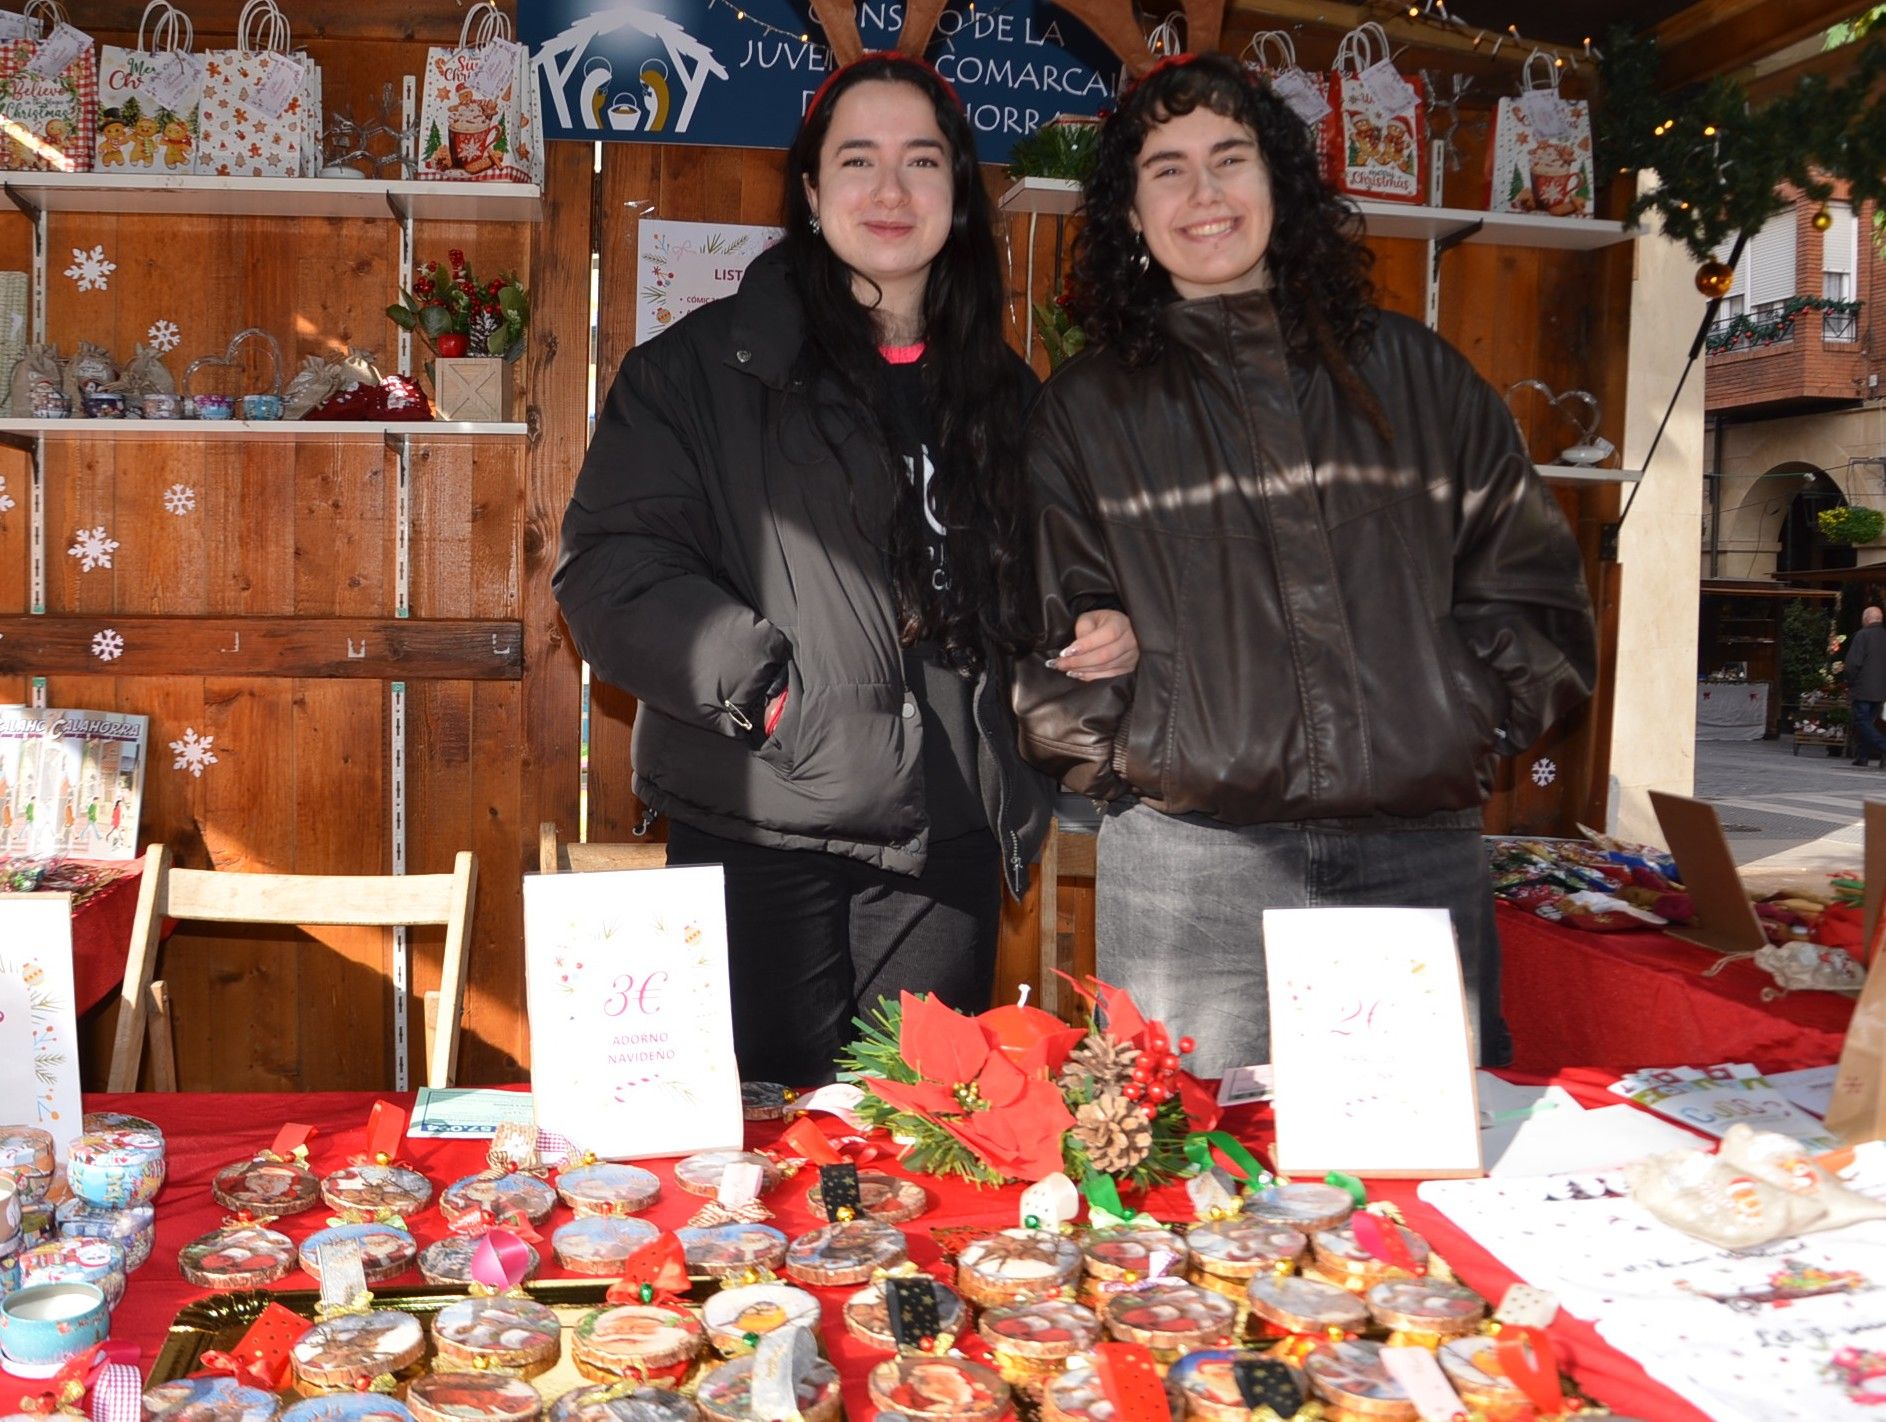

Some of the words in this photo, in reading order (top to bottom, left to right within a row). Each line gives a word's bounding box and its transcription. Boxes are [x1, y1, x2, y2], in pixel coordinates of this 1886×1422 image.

[974, 12, 1014, 42] DE
[1025, 18, 1065, 47] LA
[714, 268, 744, 281] LIST
[50, 717, 140, 740] CALAHORRA
[603, 971, 668, 1017] 3€
[612, 1032, 669, 1046] ADORNO
